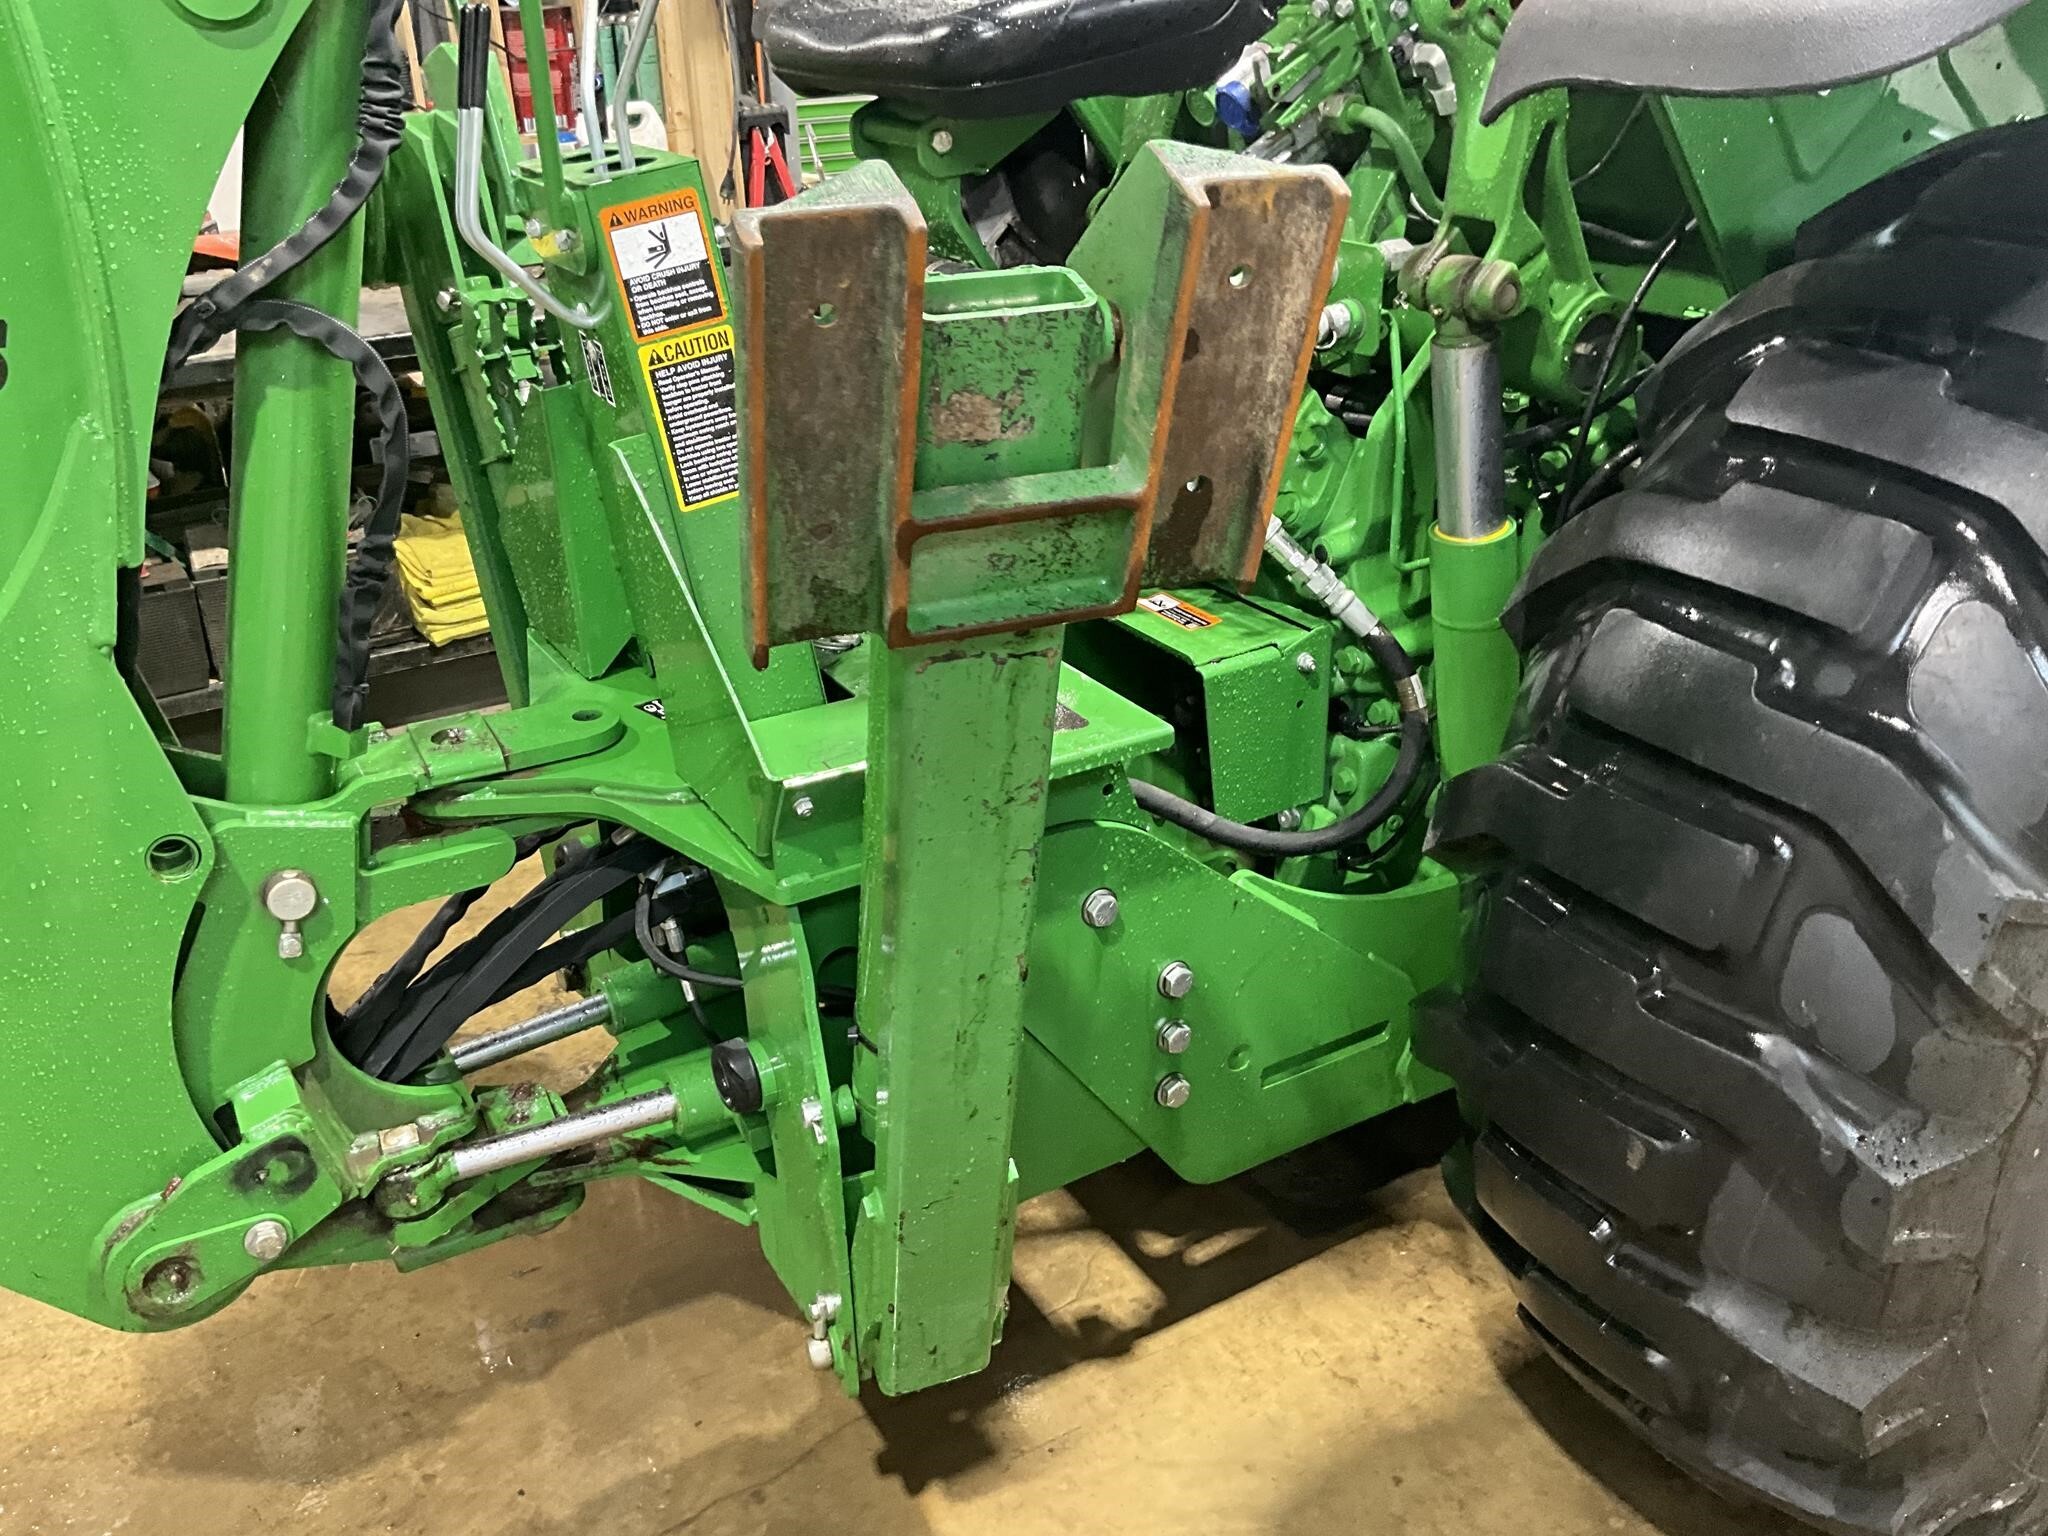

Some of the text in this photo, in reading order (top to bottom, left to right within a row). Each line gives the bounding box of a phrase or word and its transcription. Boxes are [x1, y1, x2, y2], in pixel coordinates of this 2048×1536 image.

[623, 196, 694, 222] WARNING
[629, 261, 700, 286] AVOID CRUSH INJURY
[630, 278, 667, 294] OR DEATH
[637, 307, 654, 317] when
[653, 300, 681, 311] installing
[687, 291, 714, 302] removing
[650, 317, 664, 326] NOT
[664, 330, 729, 361] CAUTION
[654, 353, 727, 379] HELP AVOID INJURY
